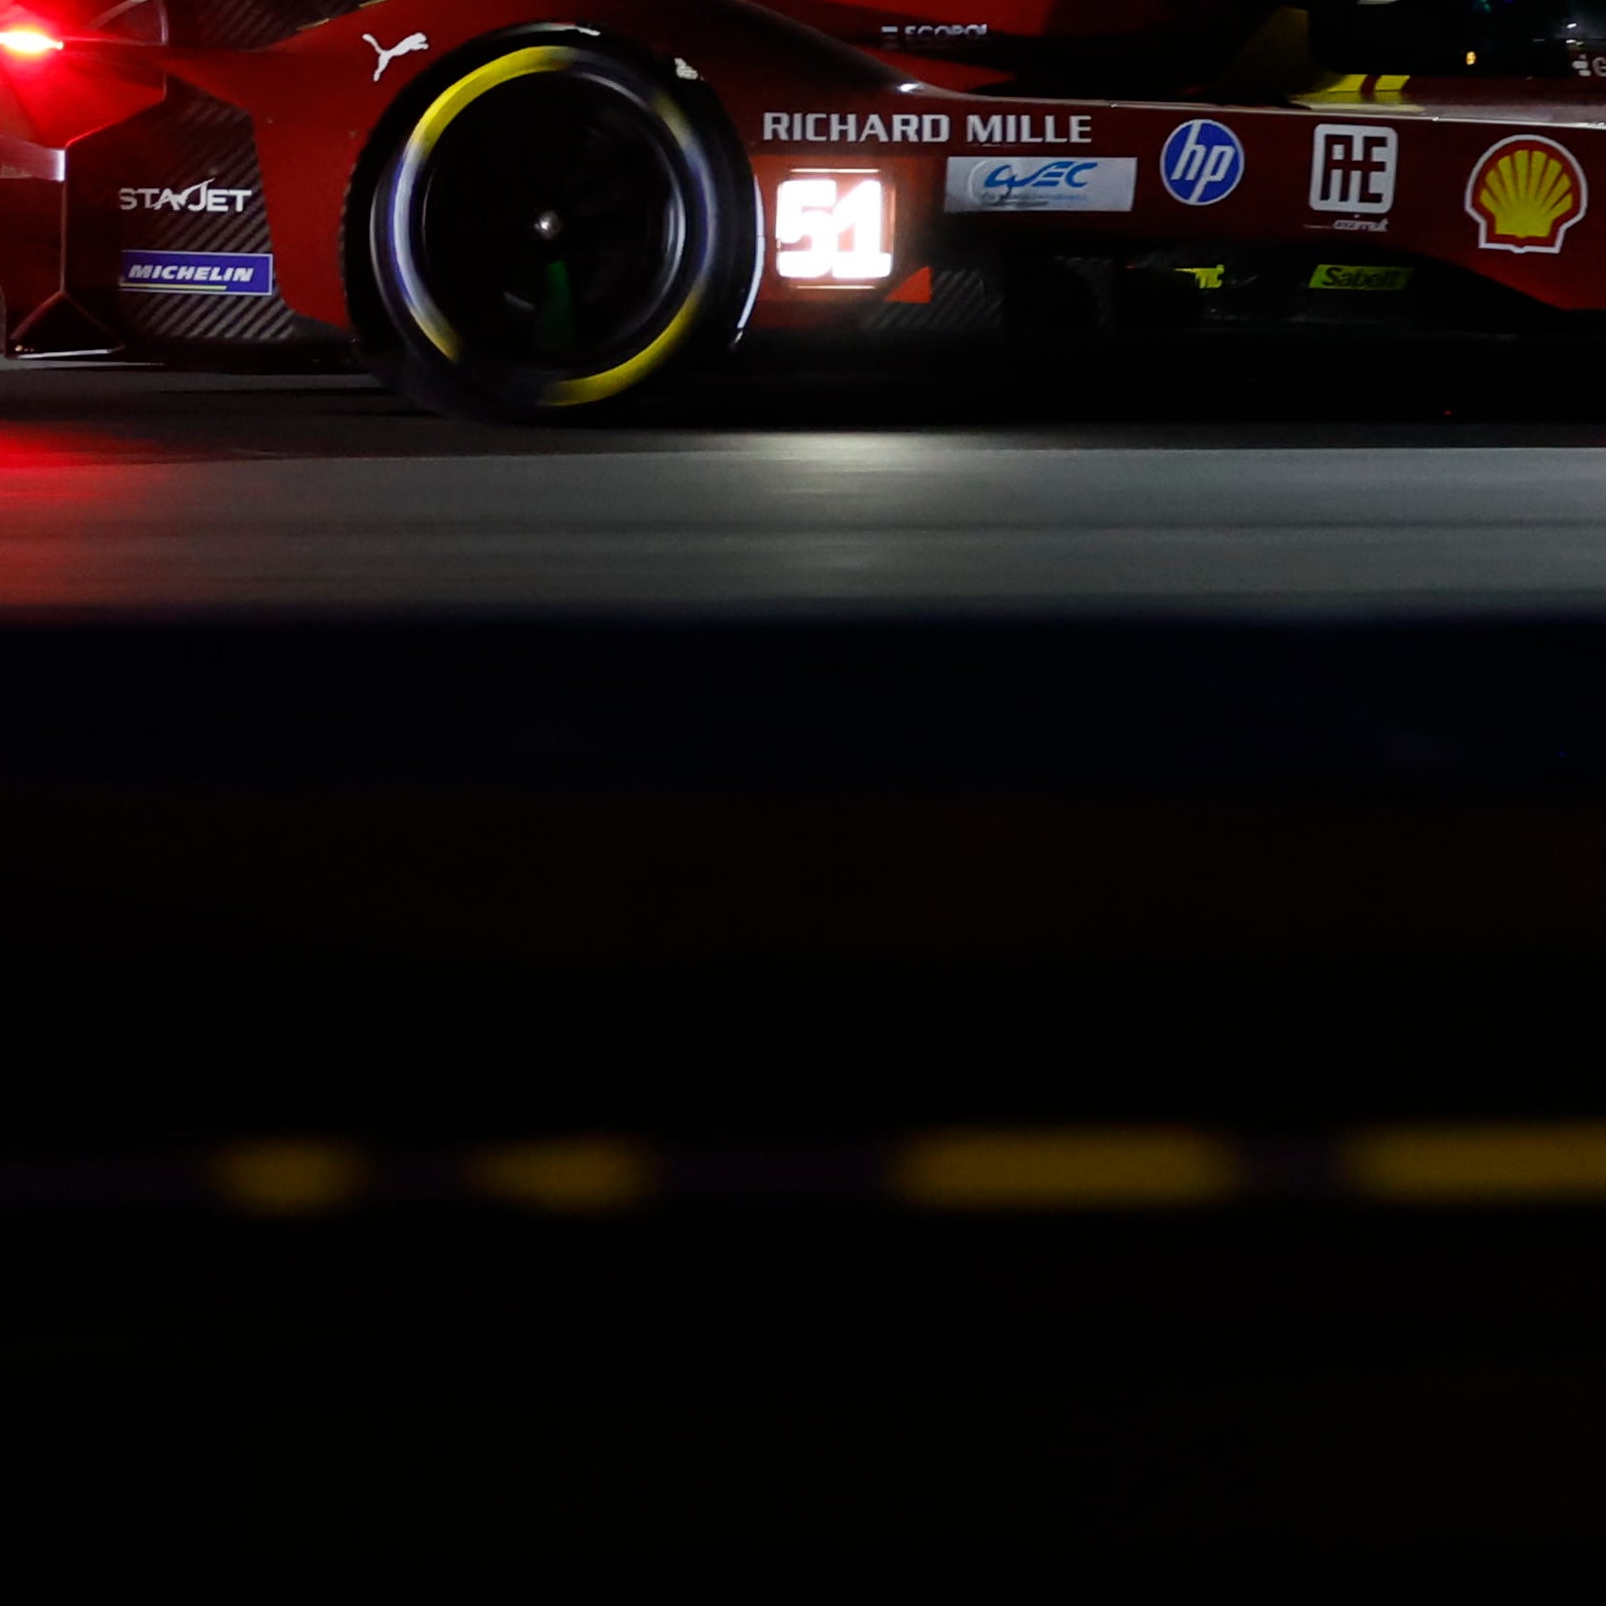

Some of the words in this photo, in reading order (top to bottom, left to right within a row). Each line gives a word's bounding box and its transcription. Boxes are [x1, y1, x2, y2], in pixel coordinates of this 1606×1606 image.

[763, 111, 951, 143] RICHARD
[965, 114, 1093, 144] MILLE
[984, 161, 1098, 188] WEC
[1169, 120, 1236, 205] hp
[775, 179, 894, 278] 51
[128, 264, 255, 283] MICHELIN
